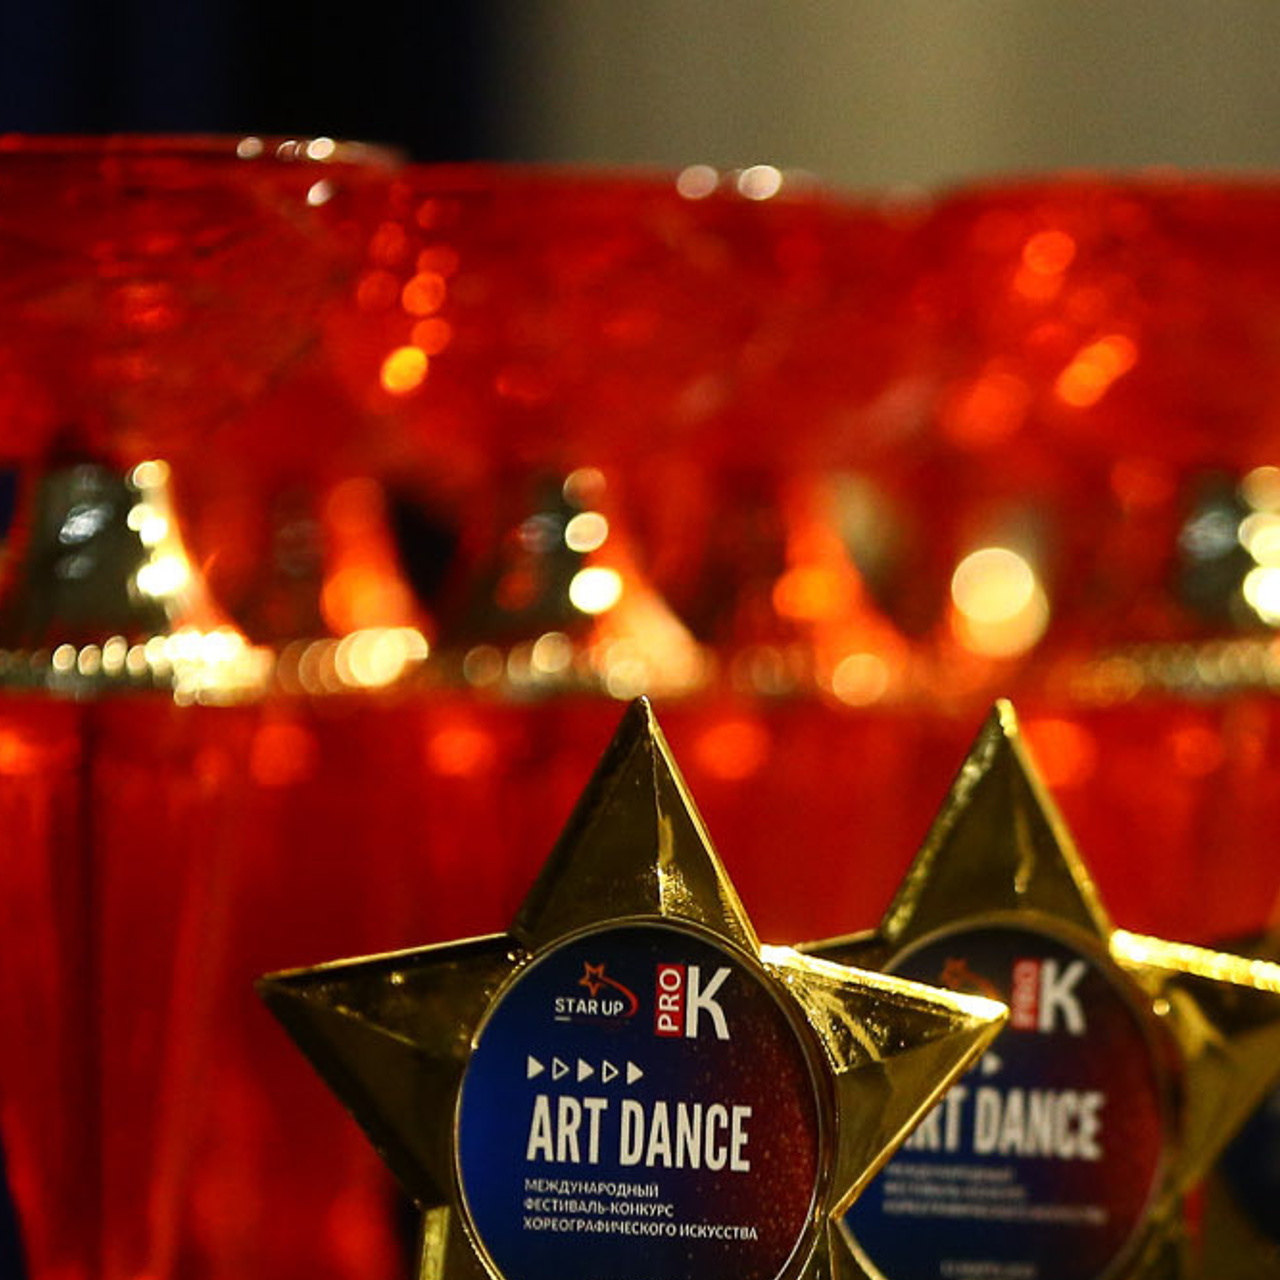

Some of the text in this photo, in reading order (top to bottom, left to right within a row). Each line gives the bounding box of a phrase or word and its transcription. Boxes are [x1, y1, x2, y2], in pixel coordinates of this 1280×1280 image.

[555, 997, 624, 1016] STAR UP
[657, 968, 682, 1032] PRO
[685, 965, 732, 1040] K
[526, 1094, 752, 1172] ART DANCE
[973, 1086, 1104, 1160] DANCE
[523, 1197, 674, 1218] ФЕСТИВАЛЬ-КОНКУРС
[524, 1177, 659, 1198] МЕЖДУНАРОДНЫЙ
[522, 1216, 758, 1242] ХОРЕОГРАФИЧЕСКОГО ИСКУССТВА
